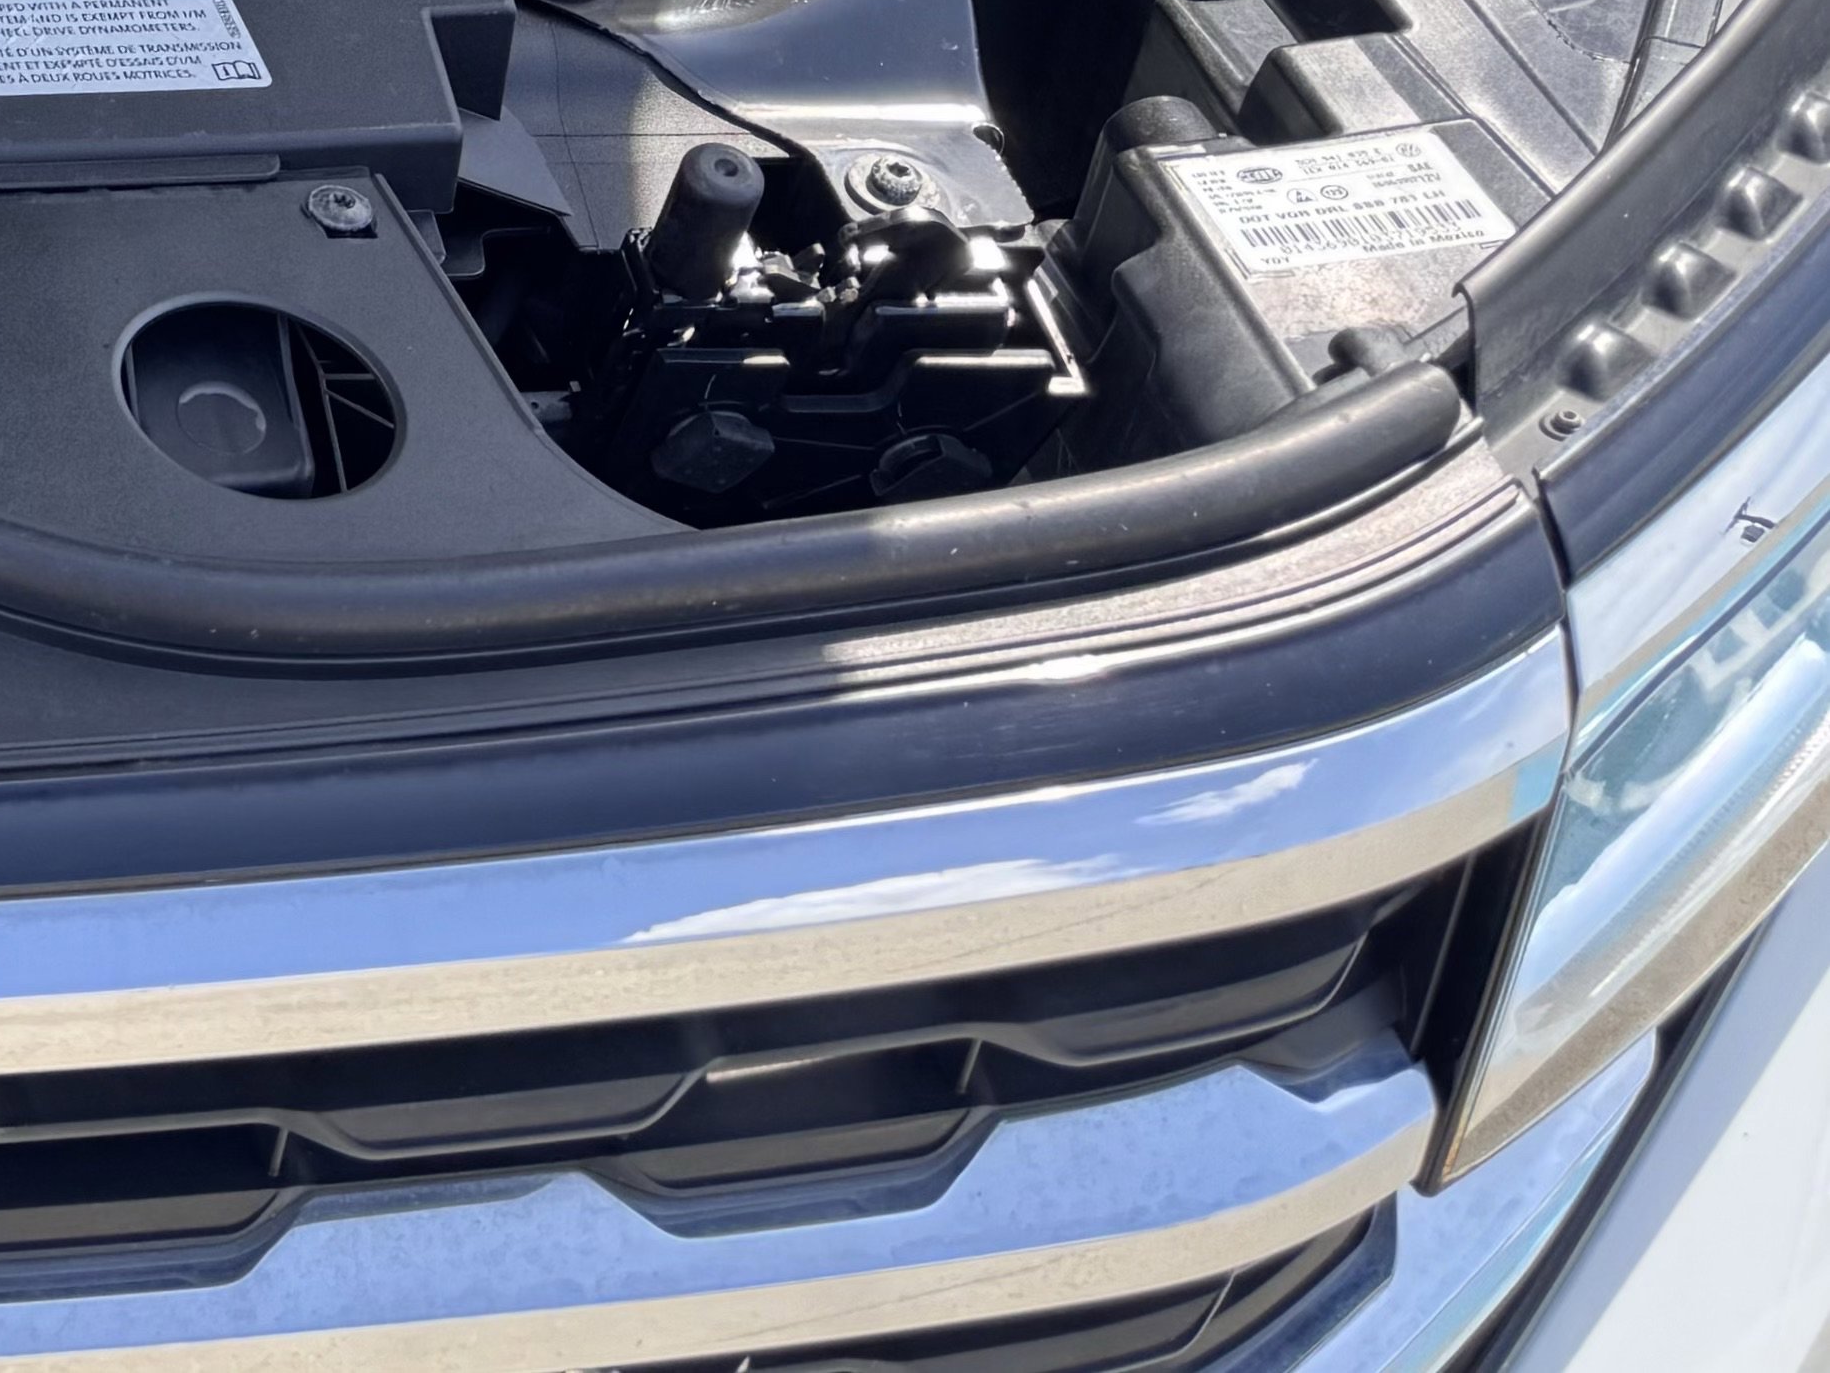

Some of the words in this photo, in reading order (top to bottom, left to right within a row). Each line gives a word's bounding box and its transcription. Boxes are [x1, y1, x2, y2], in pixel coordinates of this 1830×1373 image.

[29, 2, 67, 11] WITH
[70, 1, 82, 10] A
[66, 13, 78, 22] IS
[82, 12, 135, 22] EXEMPT
[139, 11, 179, 21] FROM
[34, 25, 75, 37] DRIVE
[117, 44, 136, 54] DE
[139, 41, 241, 53] TRANSMISSION
[26, 61, 40, 71] ET
[31, 72, 70, 83] DEUX
[74, 71, 120, 82] ROUES
[1239, 214, 1271, 224] DOT
[1363, 241, 1405, 253] Made
[1410, 237, 1425, 247] in
[1429, 231, 1484, 243] Mexico
